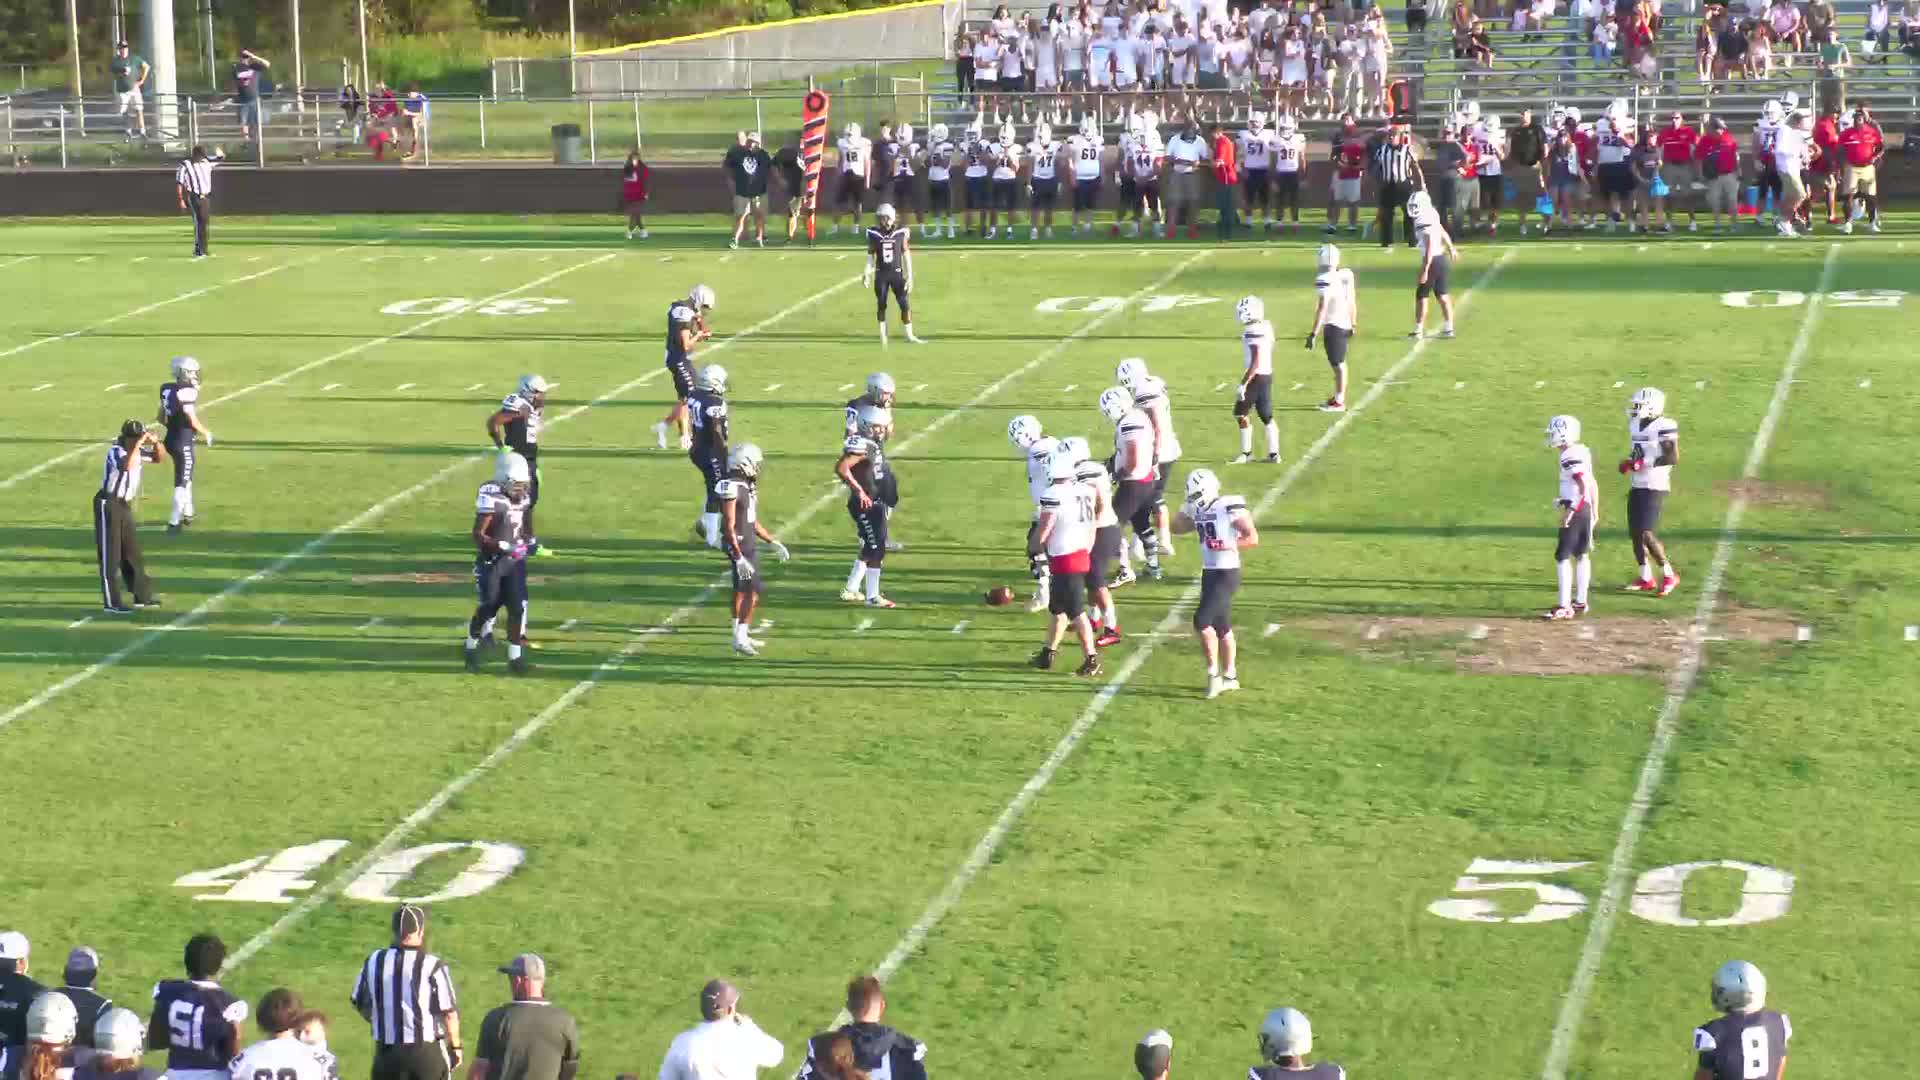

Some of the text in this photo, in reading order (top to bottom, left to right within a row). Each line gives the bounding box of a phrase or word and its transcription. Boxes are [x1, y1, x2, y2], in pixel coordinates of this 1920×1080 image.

[172, 838, 526, 904] 40
[1427, 857, 1797, 927] 50
[167, 999, 206, 1051] 51
[1741, 1025, 1769, 1080] 8
